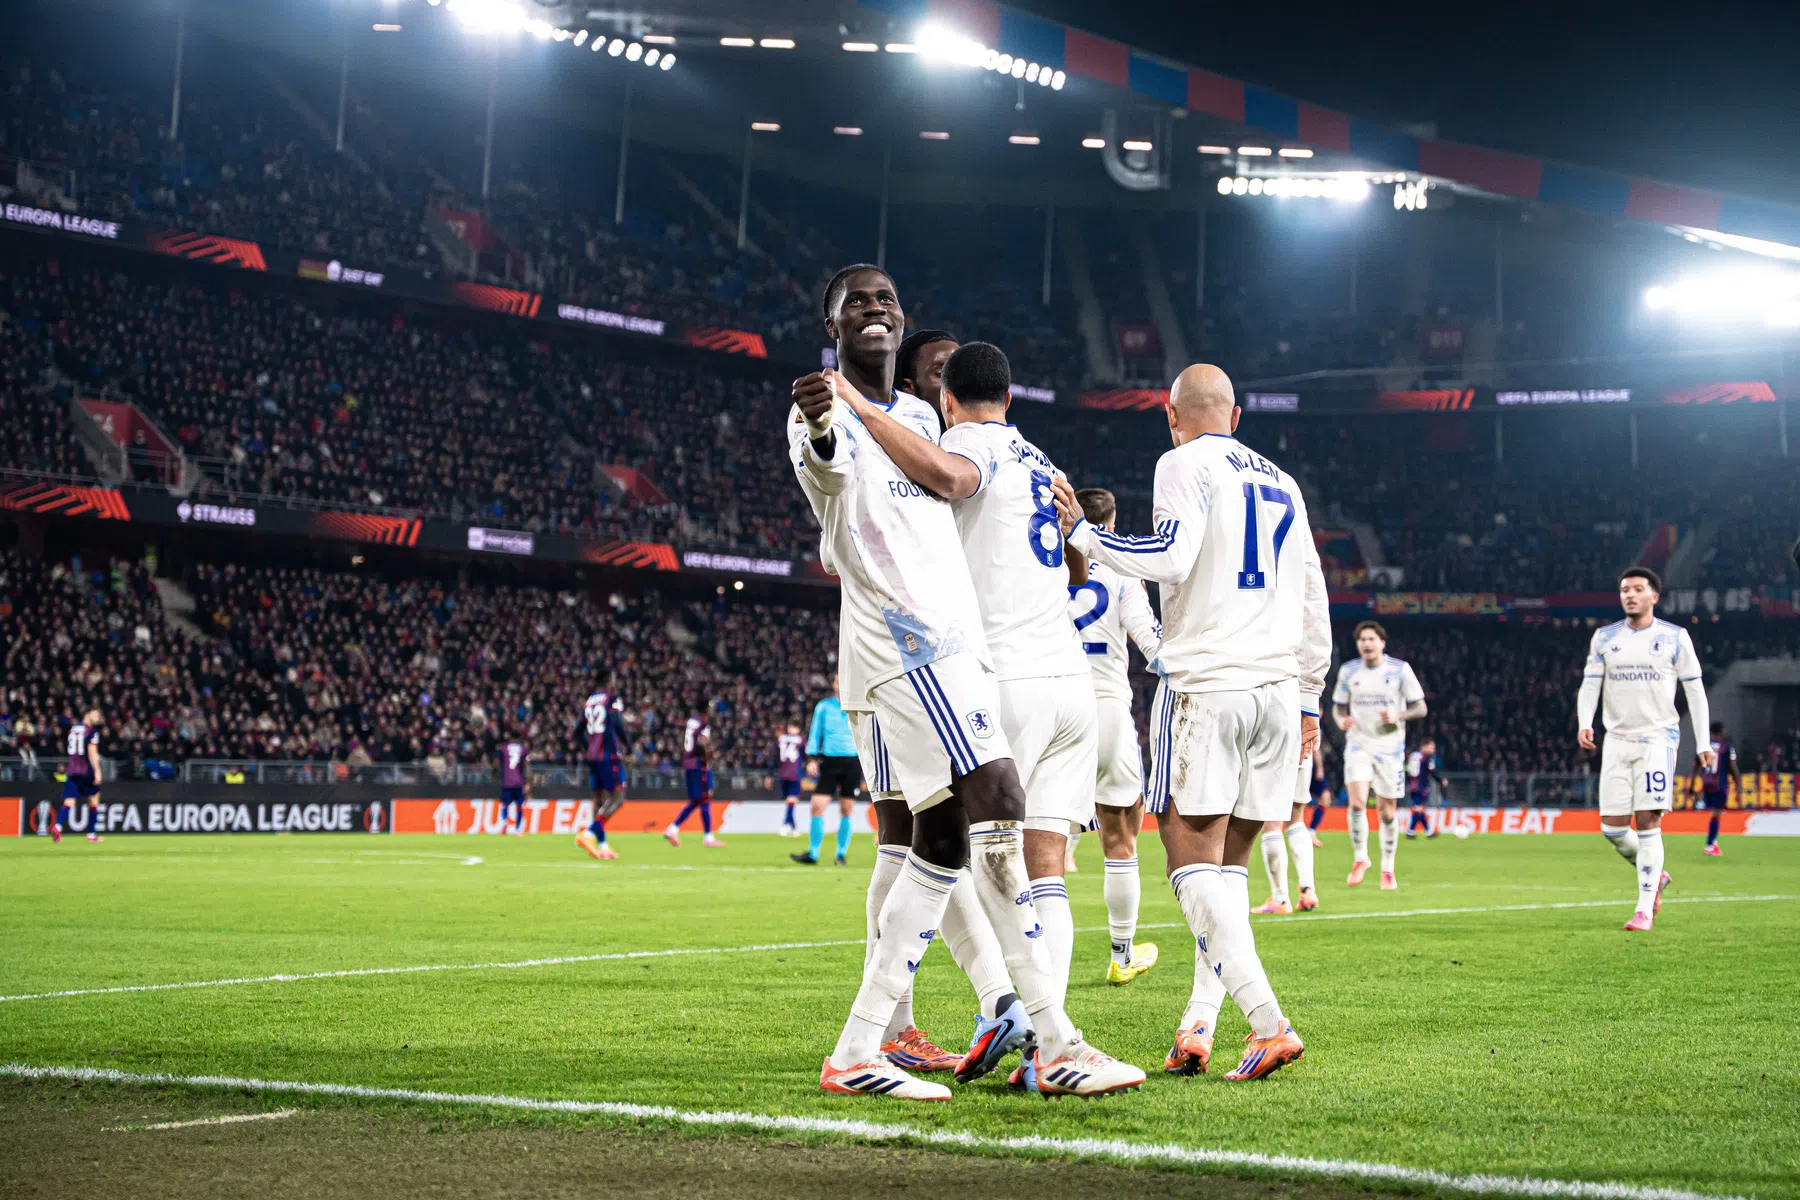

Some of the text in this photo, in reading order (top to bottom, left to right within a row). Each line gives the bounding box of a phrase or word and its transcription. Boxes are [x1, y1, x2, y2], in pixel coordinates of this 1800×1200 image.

[5, 203, 62, 229] EUROPA
[63, 213, 118, 239] LEAGUE
[192, 503, 256, 526] STRAUSS
[1028, 469, 1063, 568] 8
[1238, 481, 1295, 590] 17
[1645, 771, 1666, 793] 19
[68, 803, 353, 832] UEFA EUROPA LEAGUE
[552, 799, 595, 834] EA
[1424, 808, 1562, 834] JUST EAT
